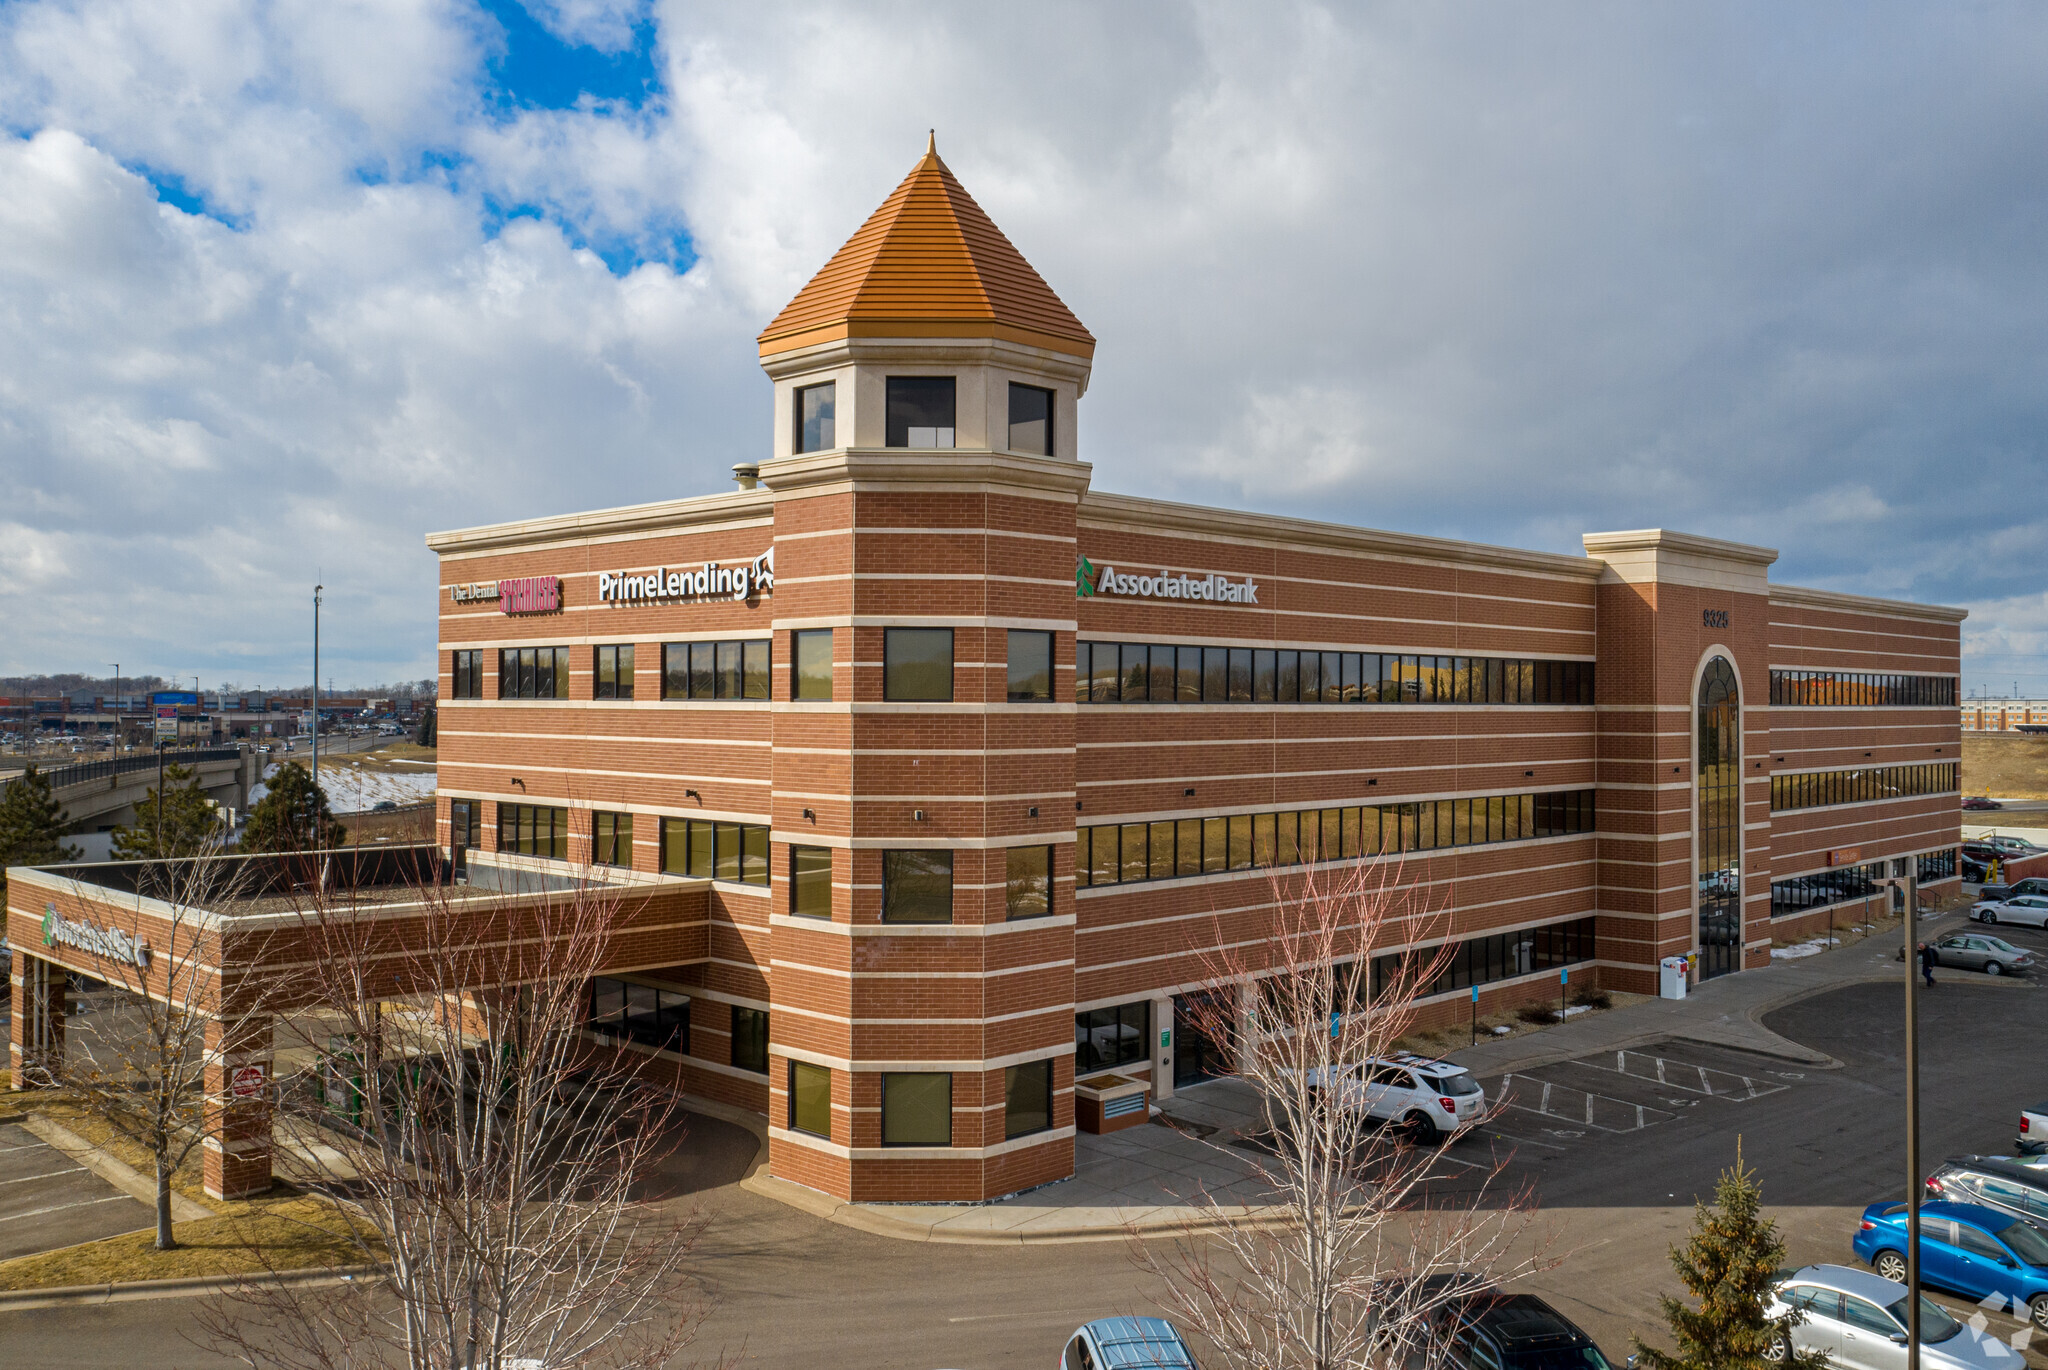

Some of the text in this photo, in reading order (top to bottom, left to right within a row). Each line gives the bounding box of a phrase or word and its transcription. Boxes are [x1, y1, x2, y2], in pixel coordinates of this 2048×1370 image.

[447, 580, 499, 600] The Dental
[499, 575, 560, 613] SPECIALISTS
[599, 563, 751, 601] PrimeLending
[1703, 608, 1729, 629] 9325
